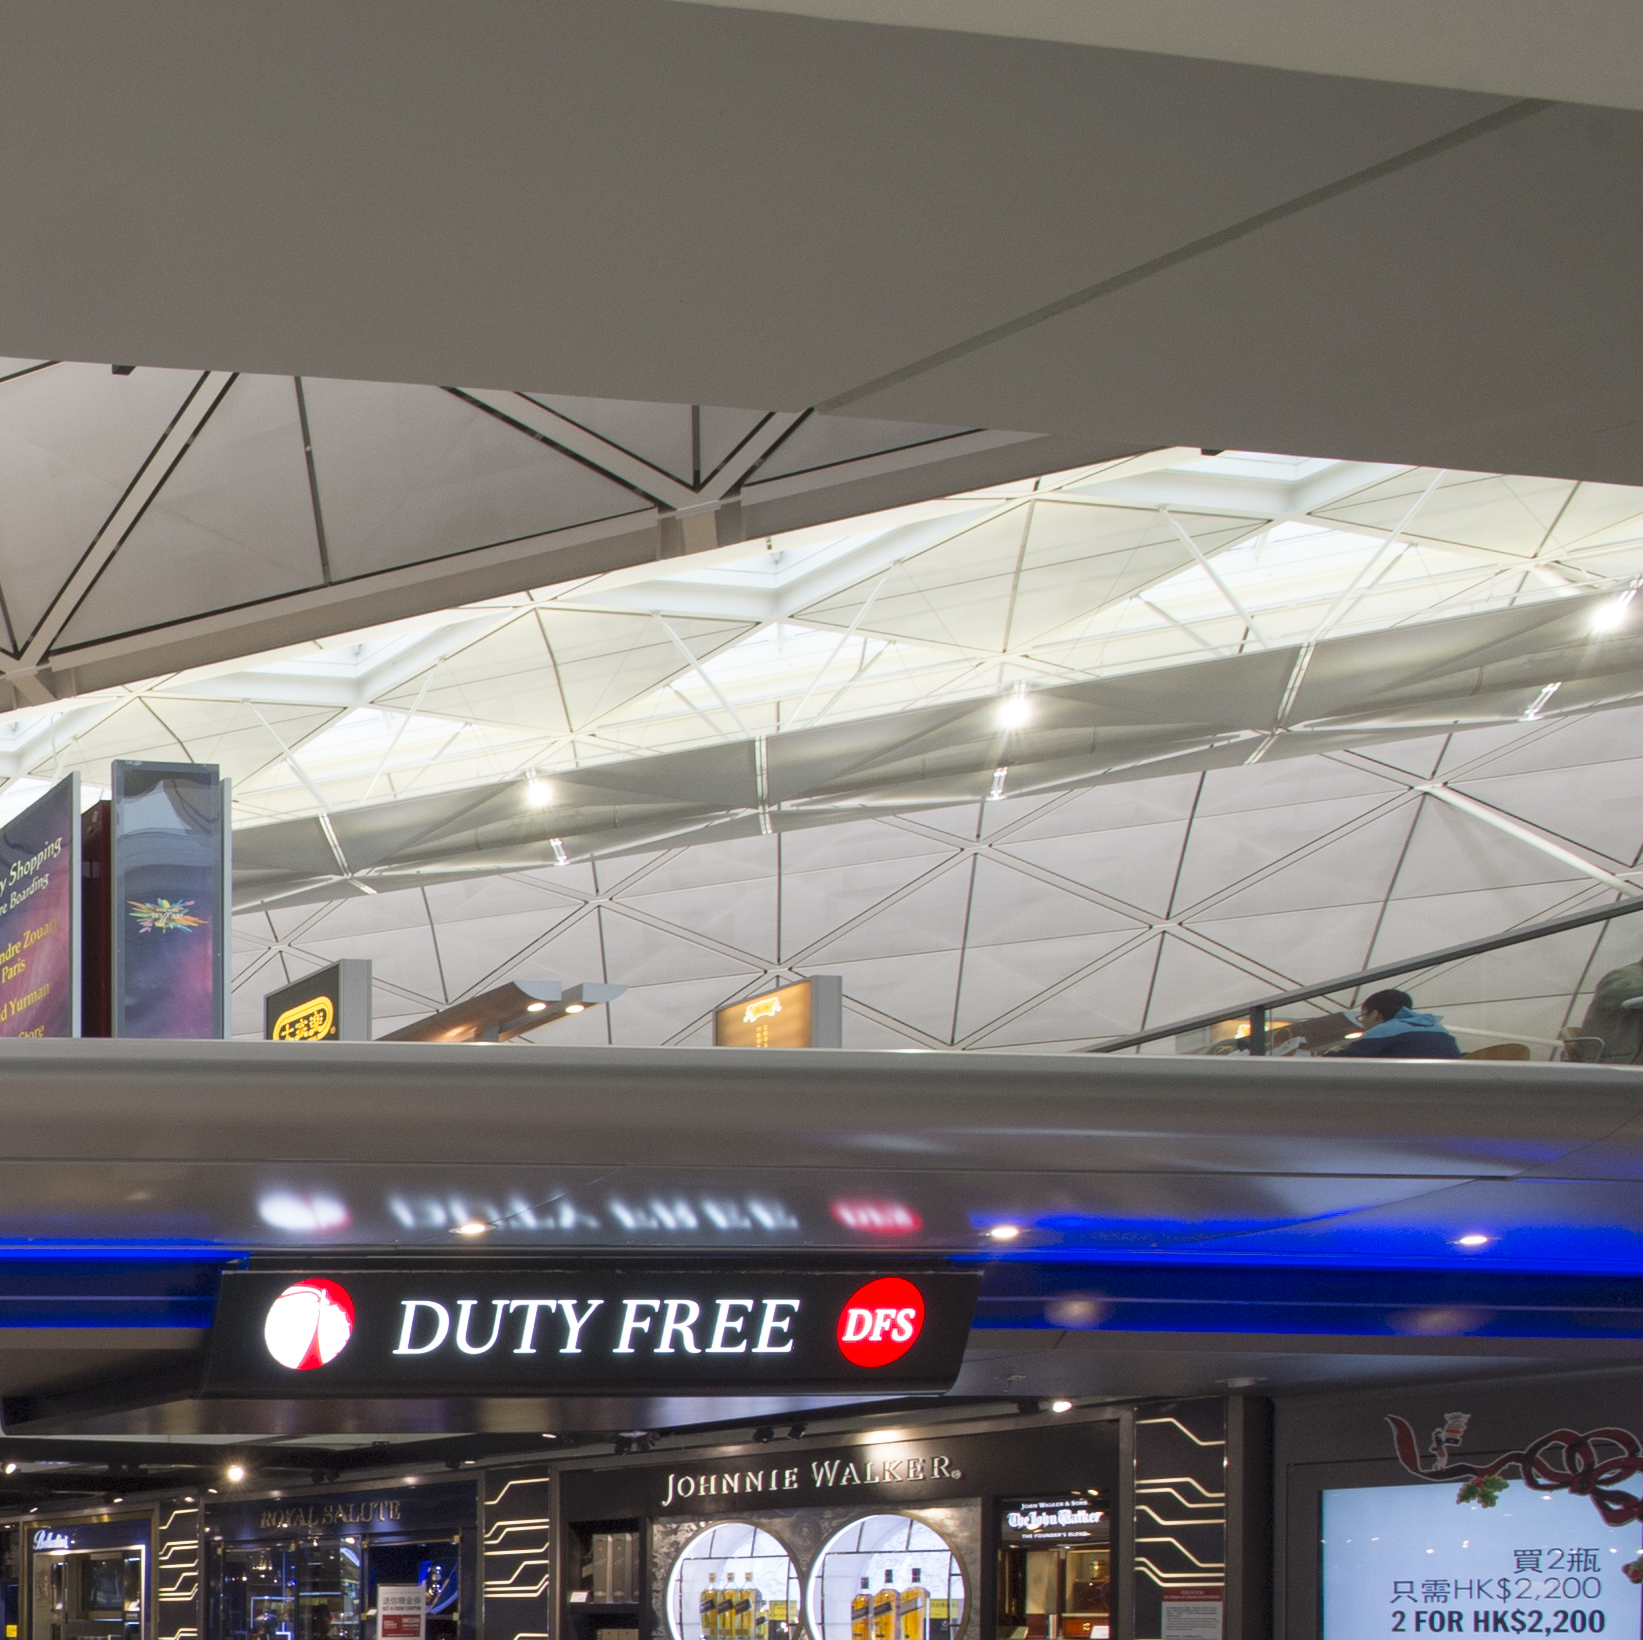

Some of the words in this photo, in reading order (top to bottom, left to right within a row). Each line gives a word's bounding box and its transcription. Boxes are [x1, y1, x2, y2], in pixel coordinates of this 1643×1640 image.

[9, 836, 63, 887] Shopping
[9, 872, 49, 910] Boarding
[1, 957, 26, 984] Paris
[9, 982, 50, 1017] Yurman
[393, 1298, 604, 1355] DUTY
[613, 1298, 801, 1355] FREE
[842, 1306, 916, 1343] DFS
[662, 1467, 799, 1506] JOHNNIE
[811, 1455, 955, 1487] WALKER
[260, 1507, 320, 1528] ROYAL
[322, 1500, 401, 1524] SALUTE
[1513, 1547, 1601, 1574] 買2瓶
[1390, 1577, 1602, 1604] 只需HK$2,200
[1391, 1610, 1406, 1632] 2
[1415, 1610, 1464, 1633] FOR
[1473, 1608, 1605, 1637] HK$2,200
